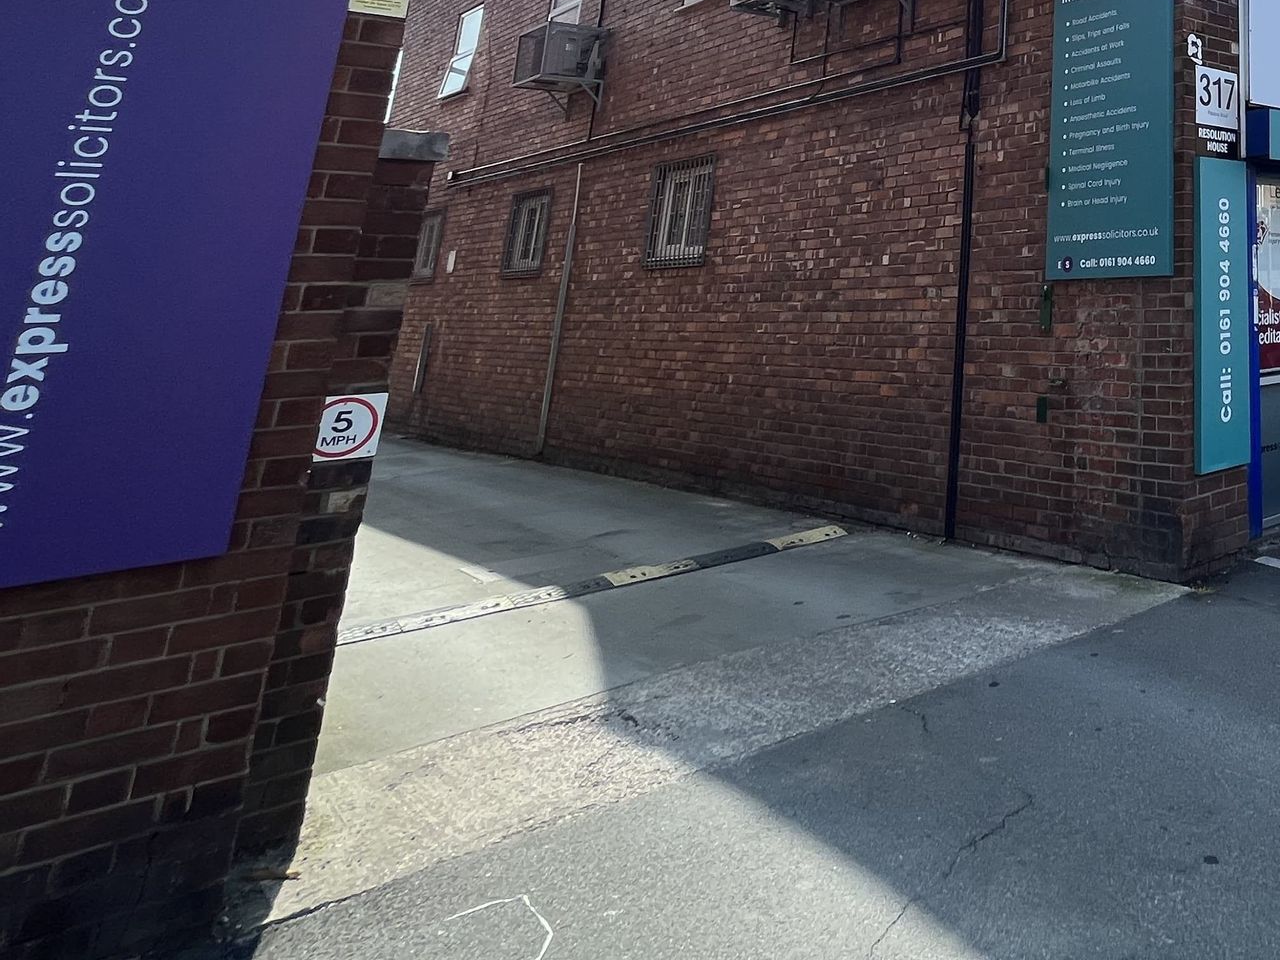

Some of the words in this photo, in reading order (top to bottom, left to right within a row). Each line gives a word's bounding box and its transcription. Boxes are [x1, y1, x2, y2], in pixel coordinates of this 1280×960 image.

[1199, 73, 1235, 110] 317
[1198, 127, 1236, 143] RESOLUTION
[1206, 141, 1228, 153] HOUSE
[1053, 226, 1159, 243] www.expresssolicitors.co.uk
[1218, 197, 1230, 253] 4660
[1080, 259, 1098, 268] Call:
[1099, 257, 1116, 267] 0161
[1117, 256, 1133, 266] 904
[1134, 255, 1156, 265] 4660
[1219, 259, 1231, 302] 904
[1219, 308, 1232, 356] 0161
[1220, 367, 1232, 423] Call:
[331, 409, 354, 434] 5
[320, 434, 357, 447] MPH
